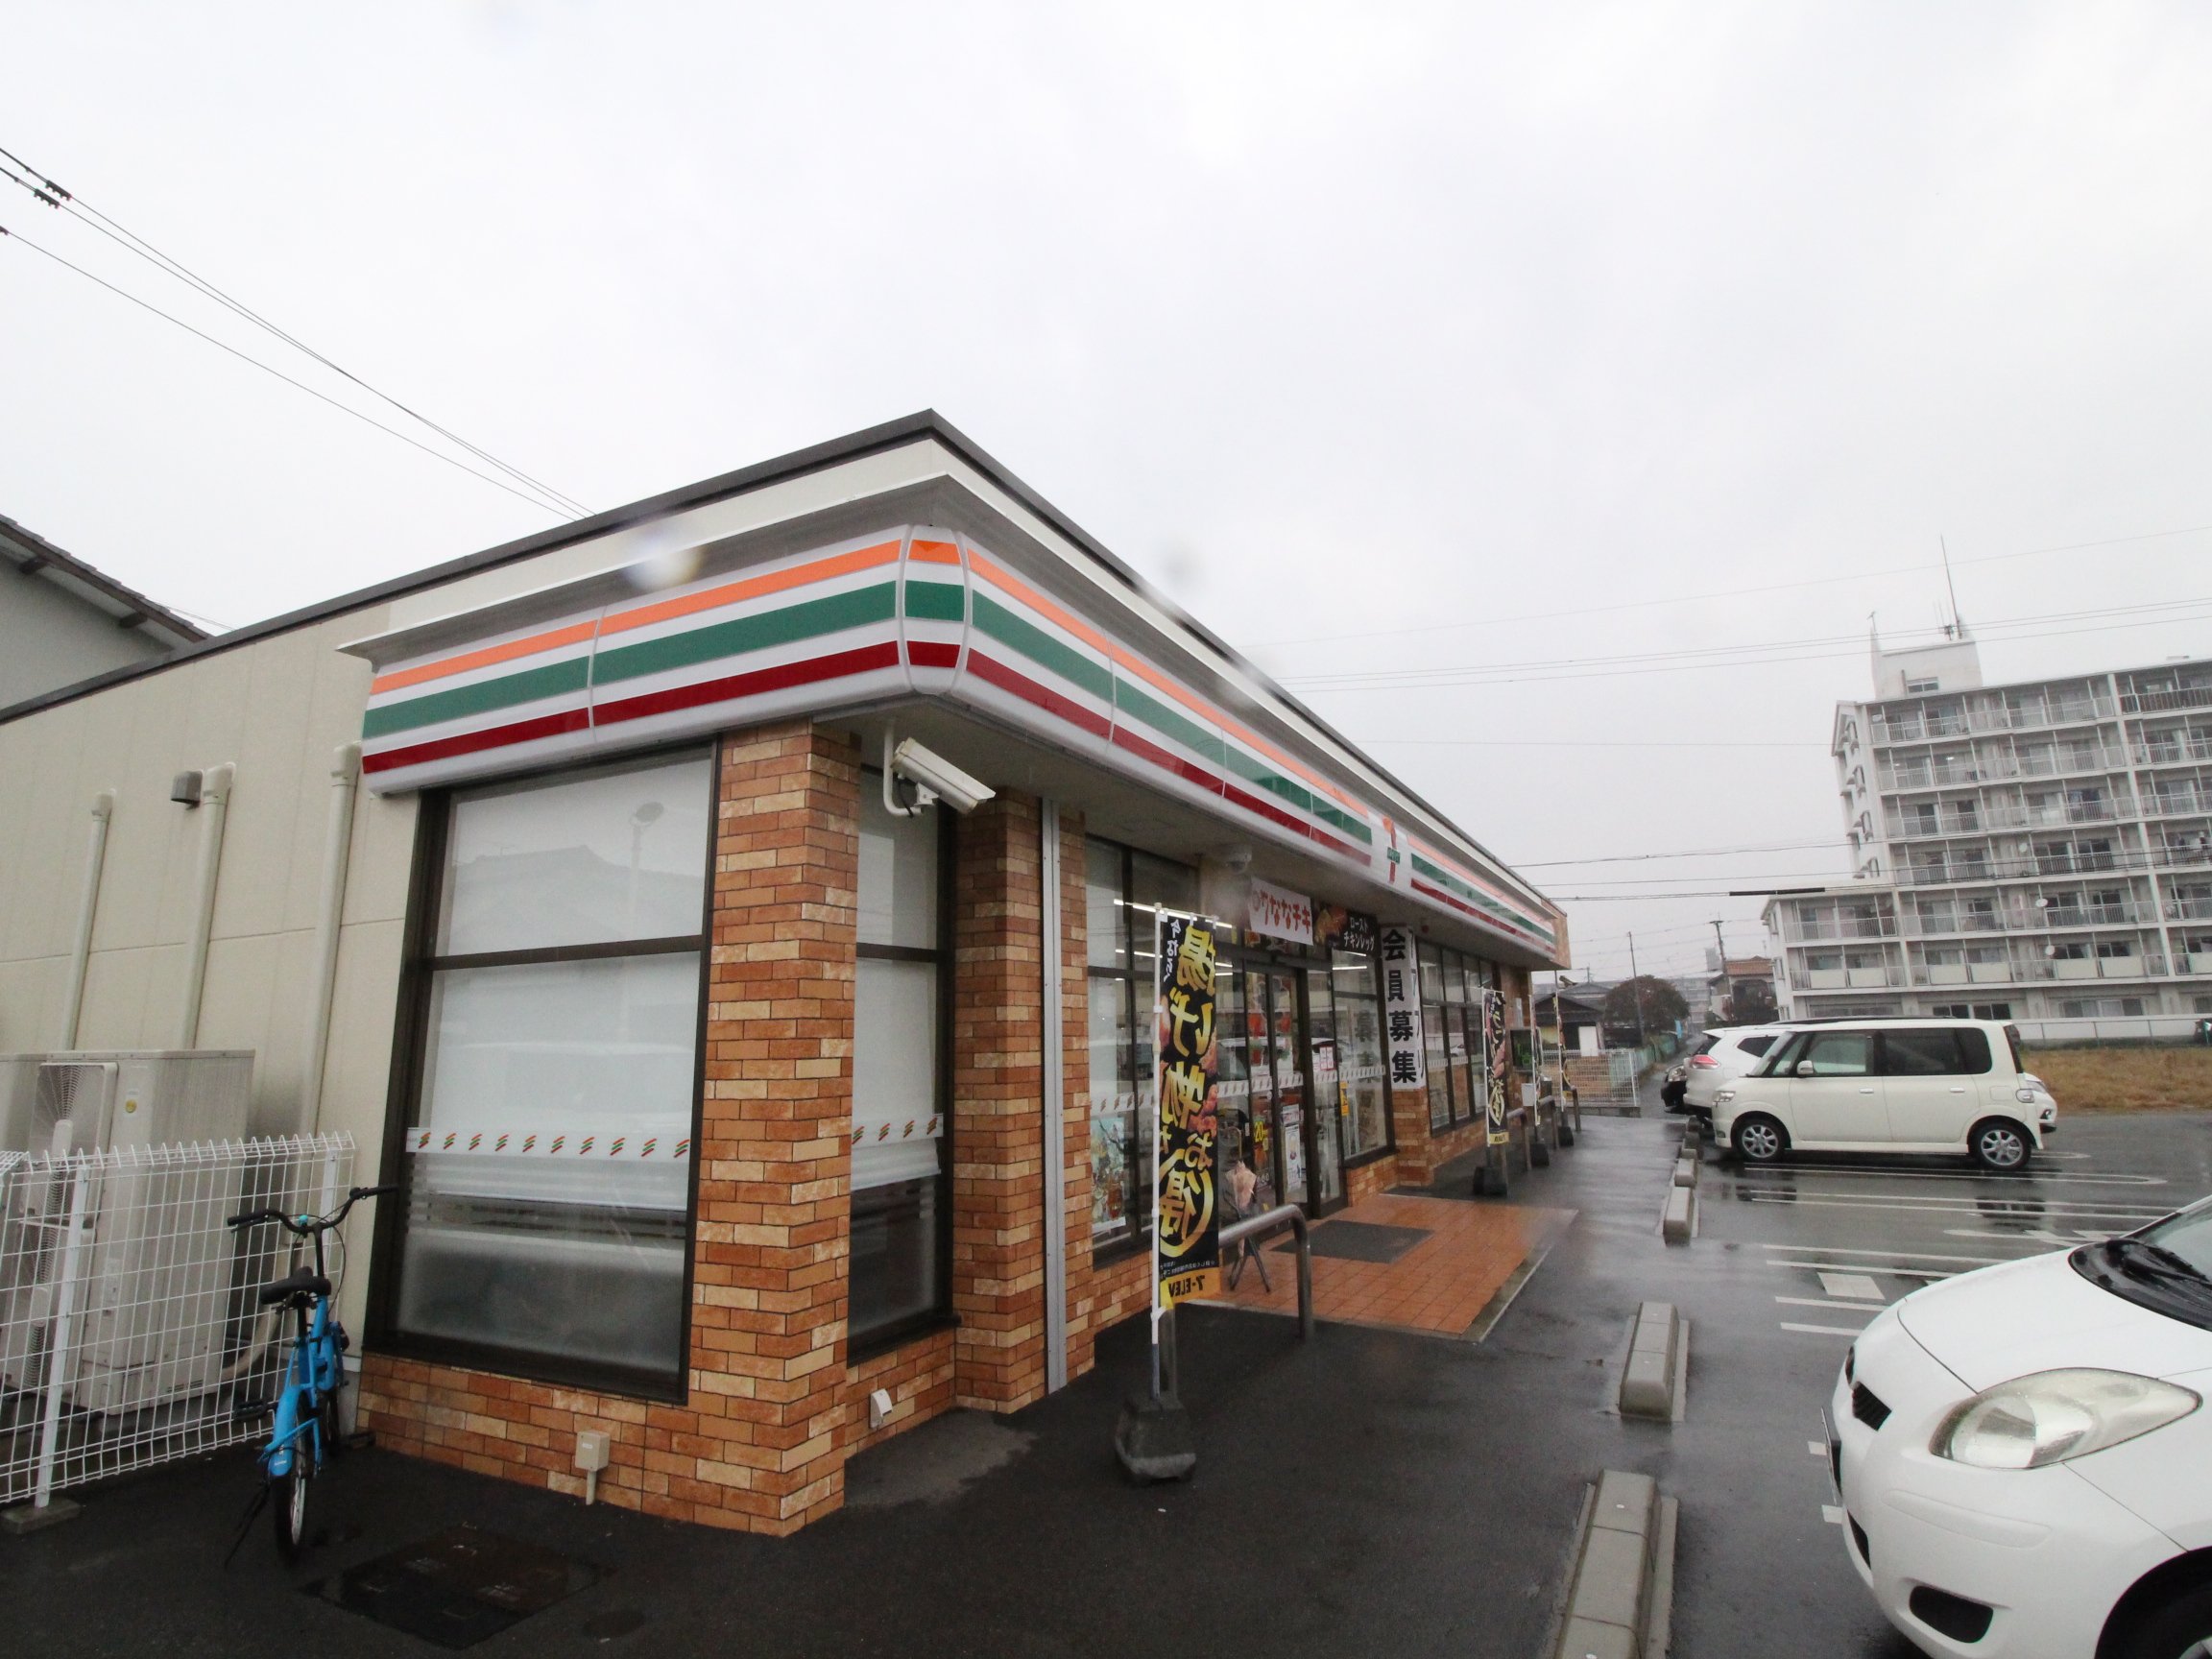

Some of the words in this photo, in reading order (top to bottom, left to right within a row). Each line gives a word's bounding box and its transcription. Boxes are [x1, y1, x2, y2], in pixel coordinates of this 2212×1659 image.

[1253, 889, 1311, 935] ななチキ
[1343, 930, 1375, 951] チキンレッグ
[1382, 928, 1417, 1084] 会員募集
